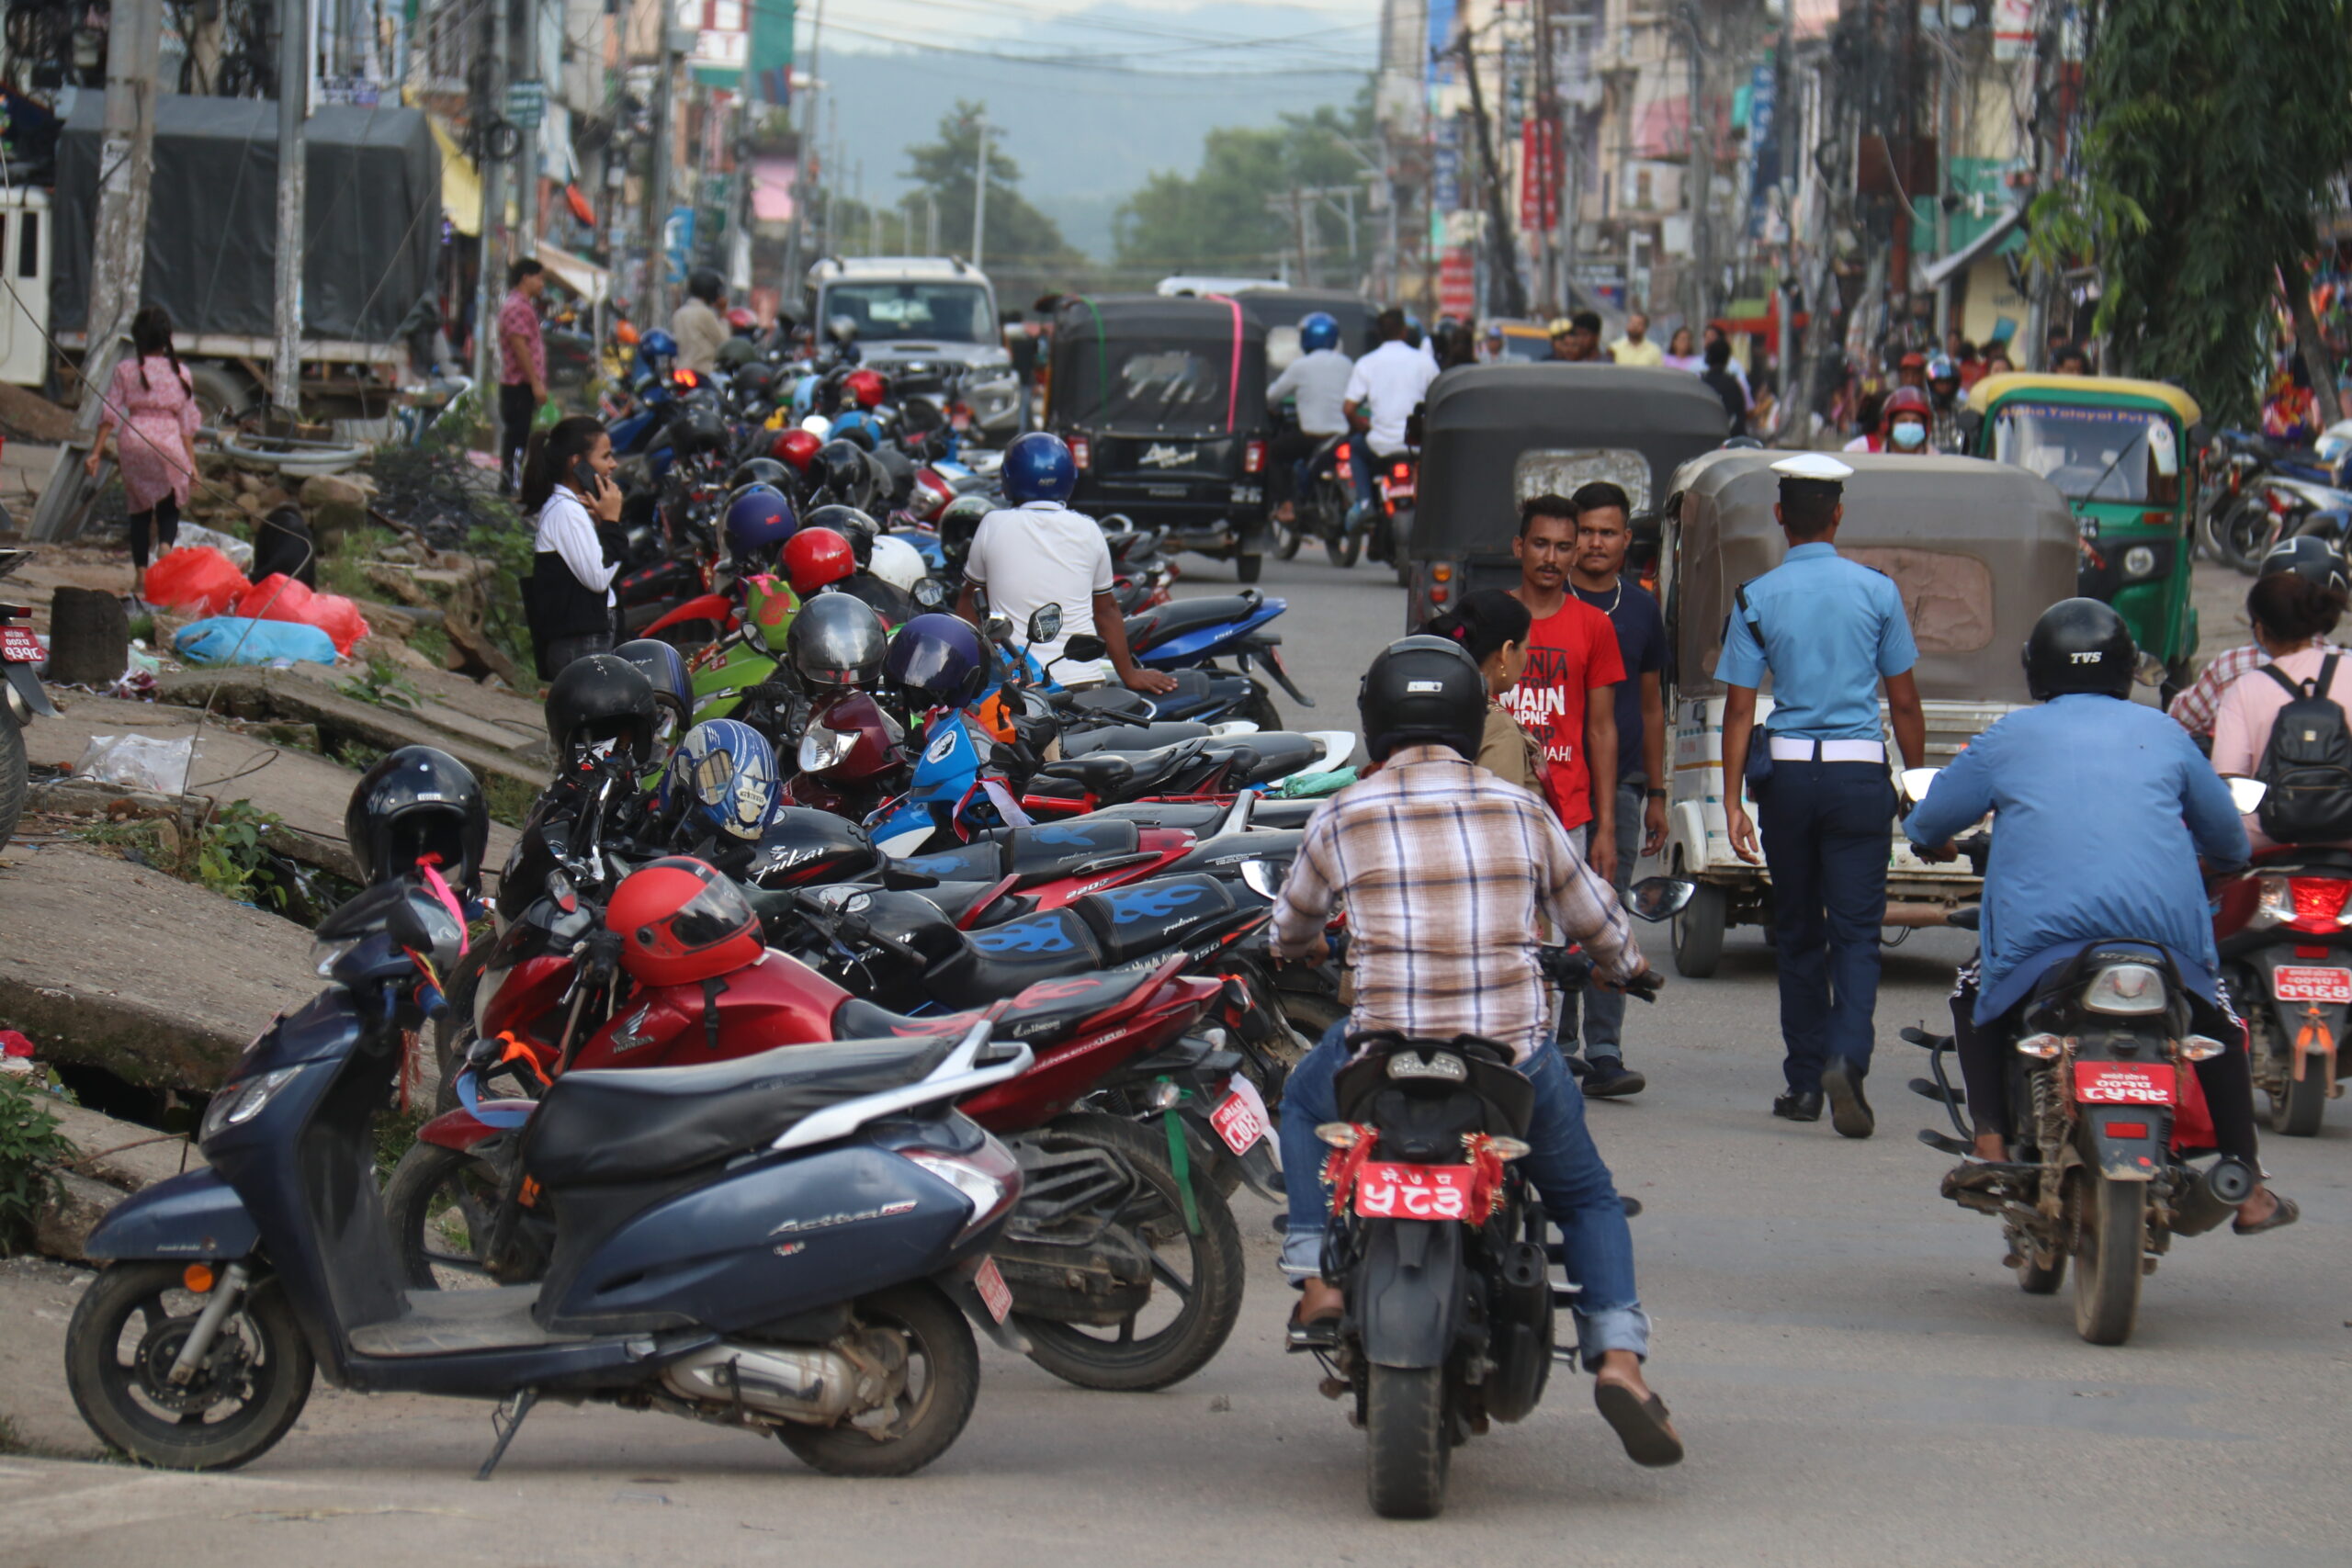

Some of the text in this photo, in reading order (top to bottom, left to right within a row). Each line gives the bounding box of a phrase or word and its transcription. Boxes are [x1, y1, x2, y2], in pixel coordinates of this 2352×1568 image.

[2070, 651, 2103, 664] TVS
[1498, 682, 1566, 716] MAIN
[1512, 710, 1551, 727] APNE
[1363, 1184, 1464, 1218] ५८३
